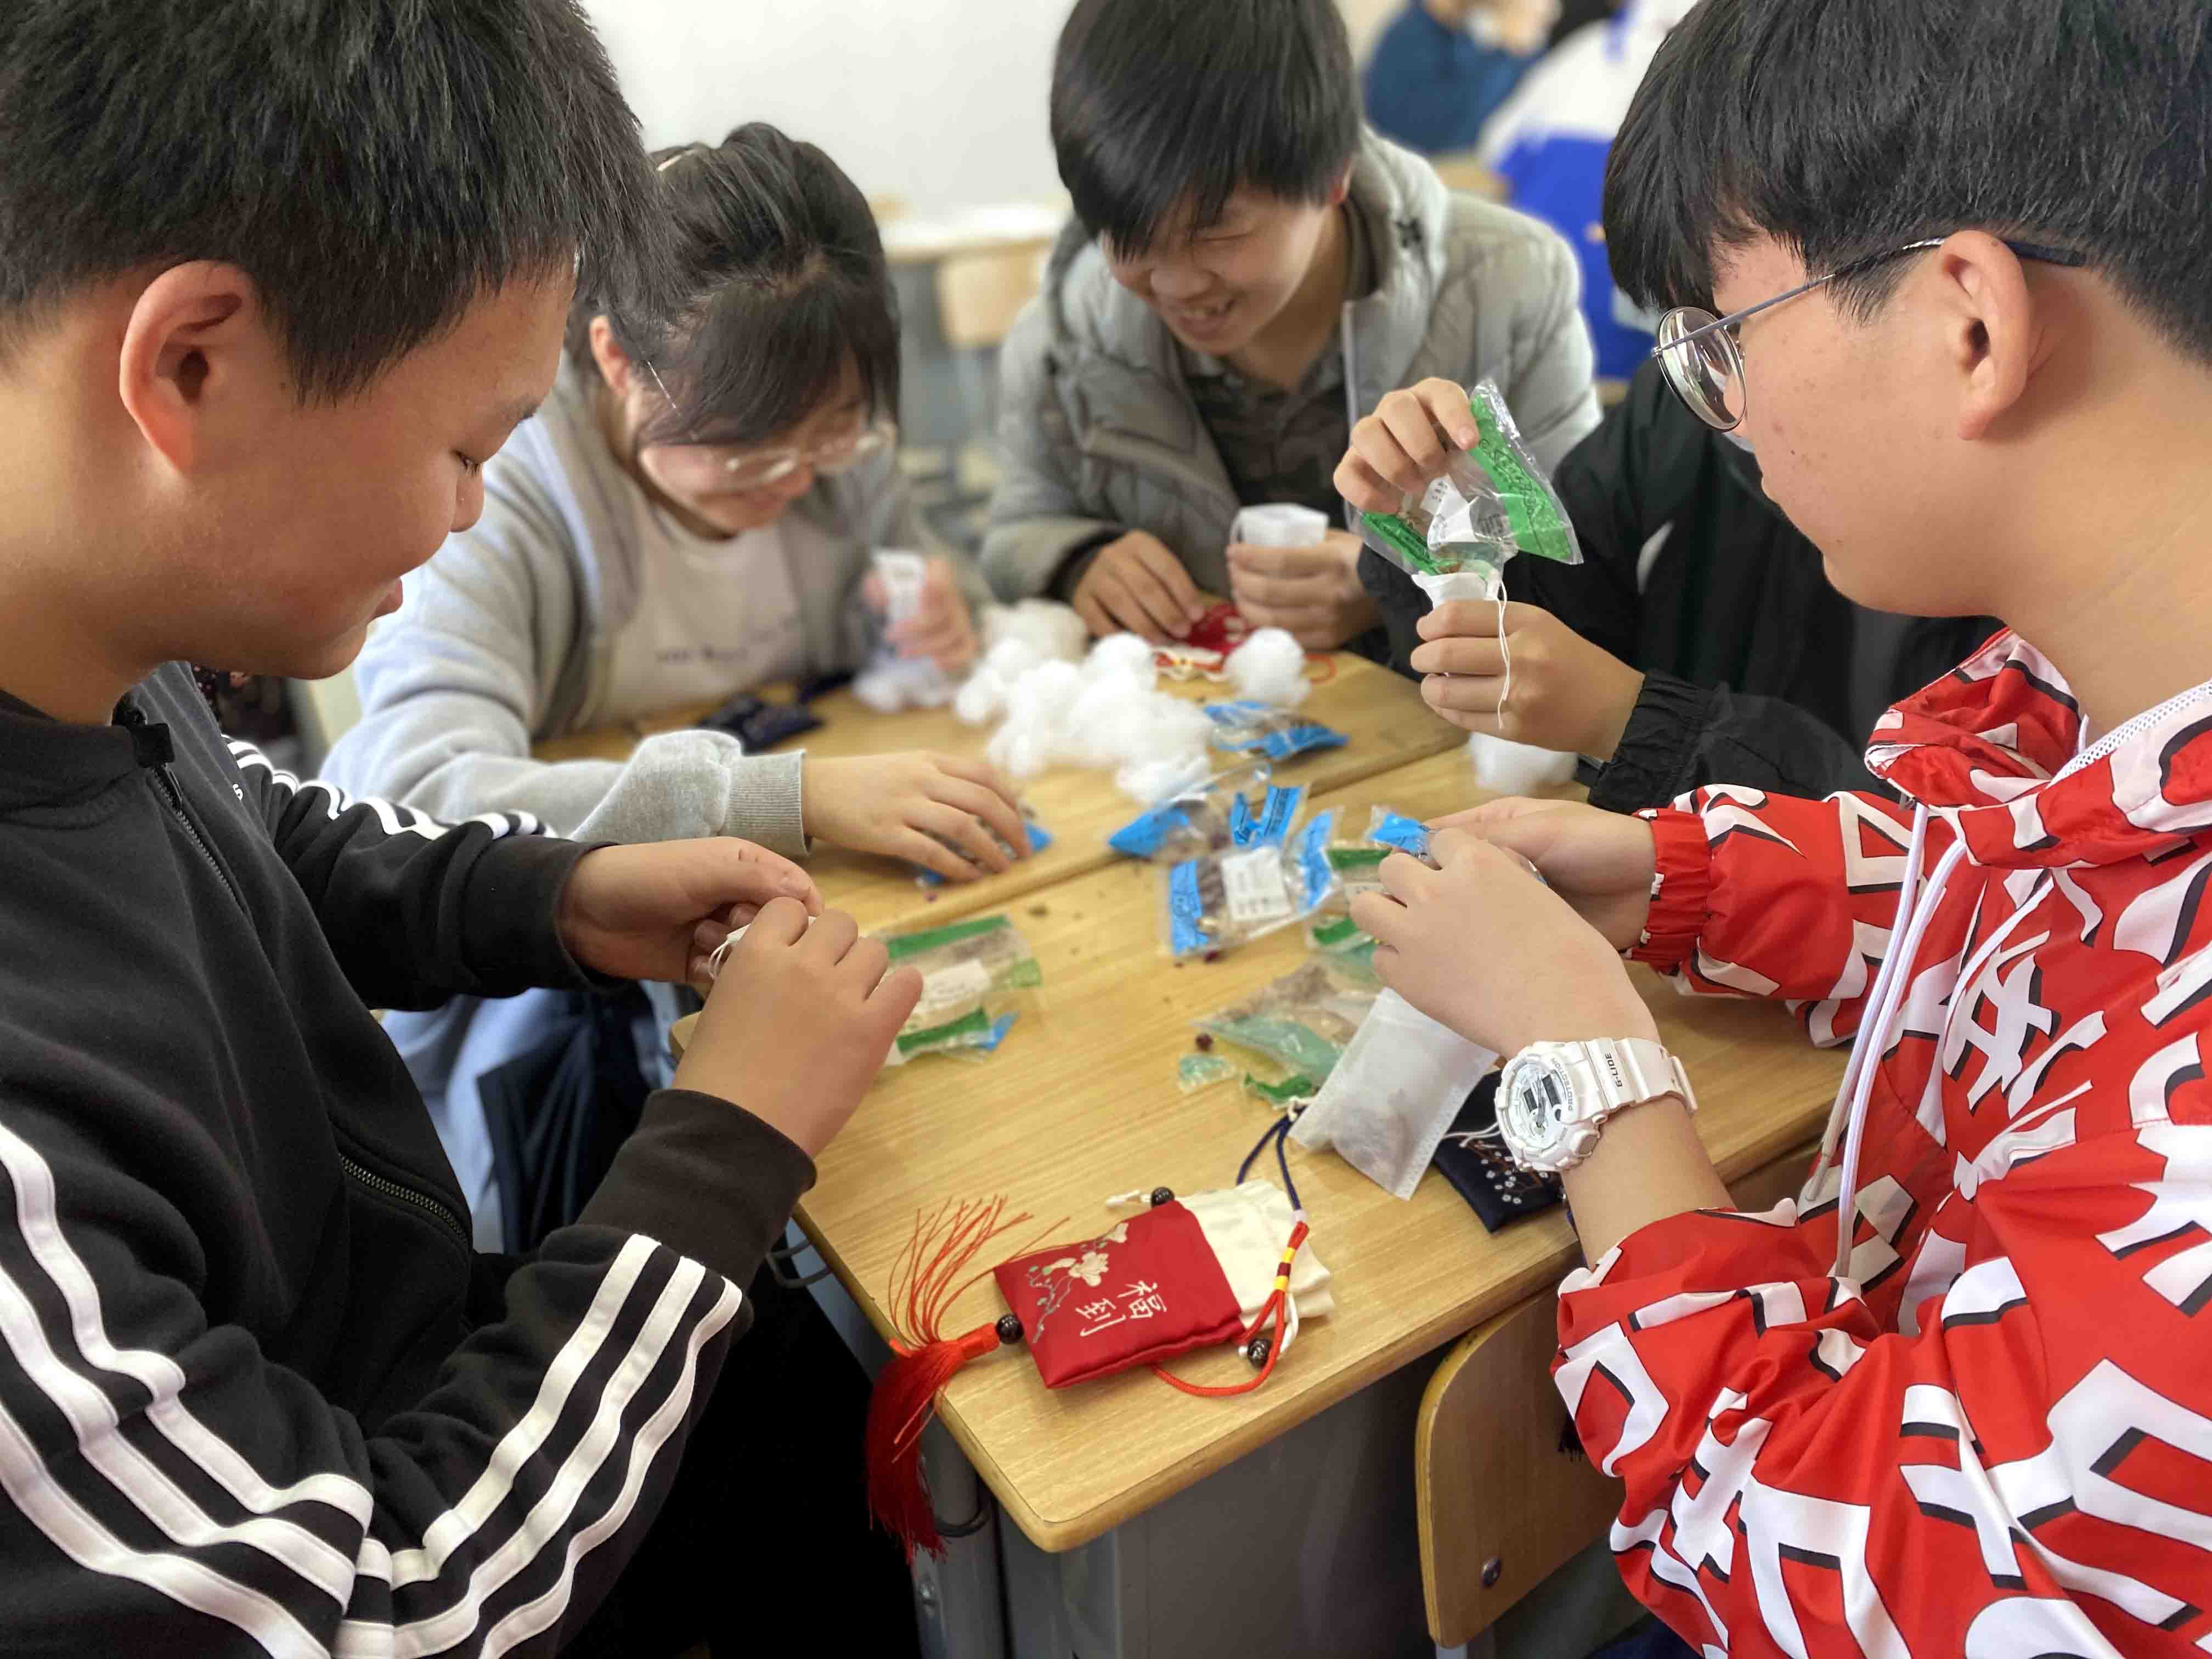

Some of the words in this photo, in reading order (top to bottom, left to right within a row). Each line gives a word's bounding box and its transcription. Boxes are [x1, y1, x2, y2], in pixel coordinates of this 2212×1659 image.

[1550, 1057, 1573, 1111] PROTECTION
[1605, 1052, 1623, 1088] G-LIDE
[1075, 1280, 1167, 1337] 福到
